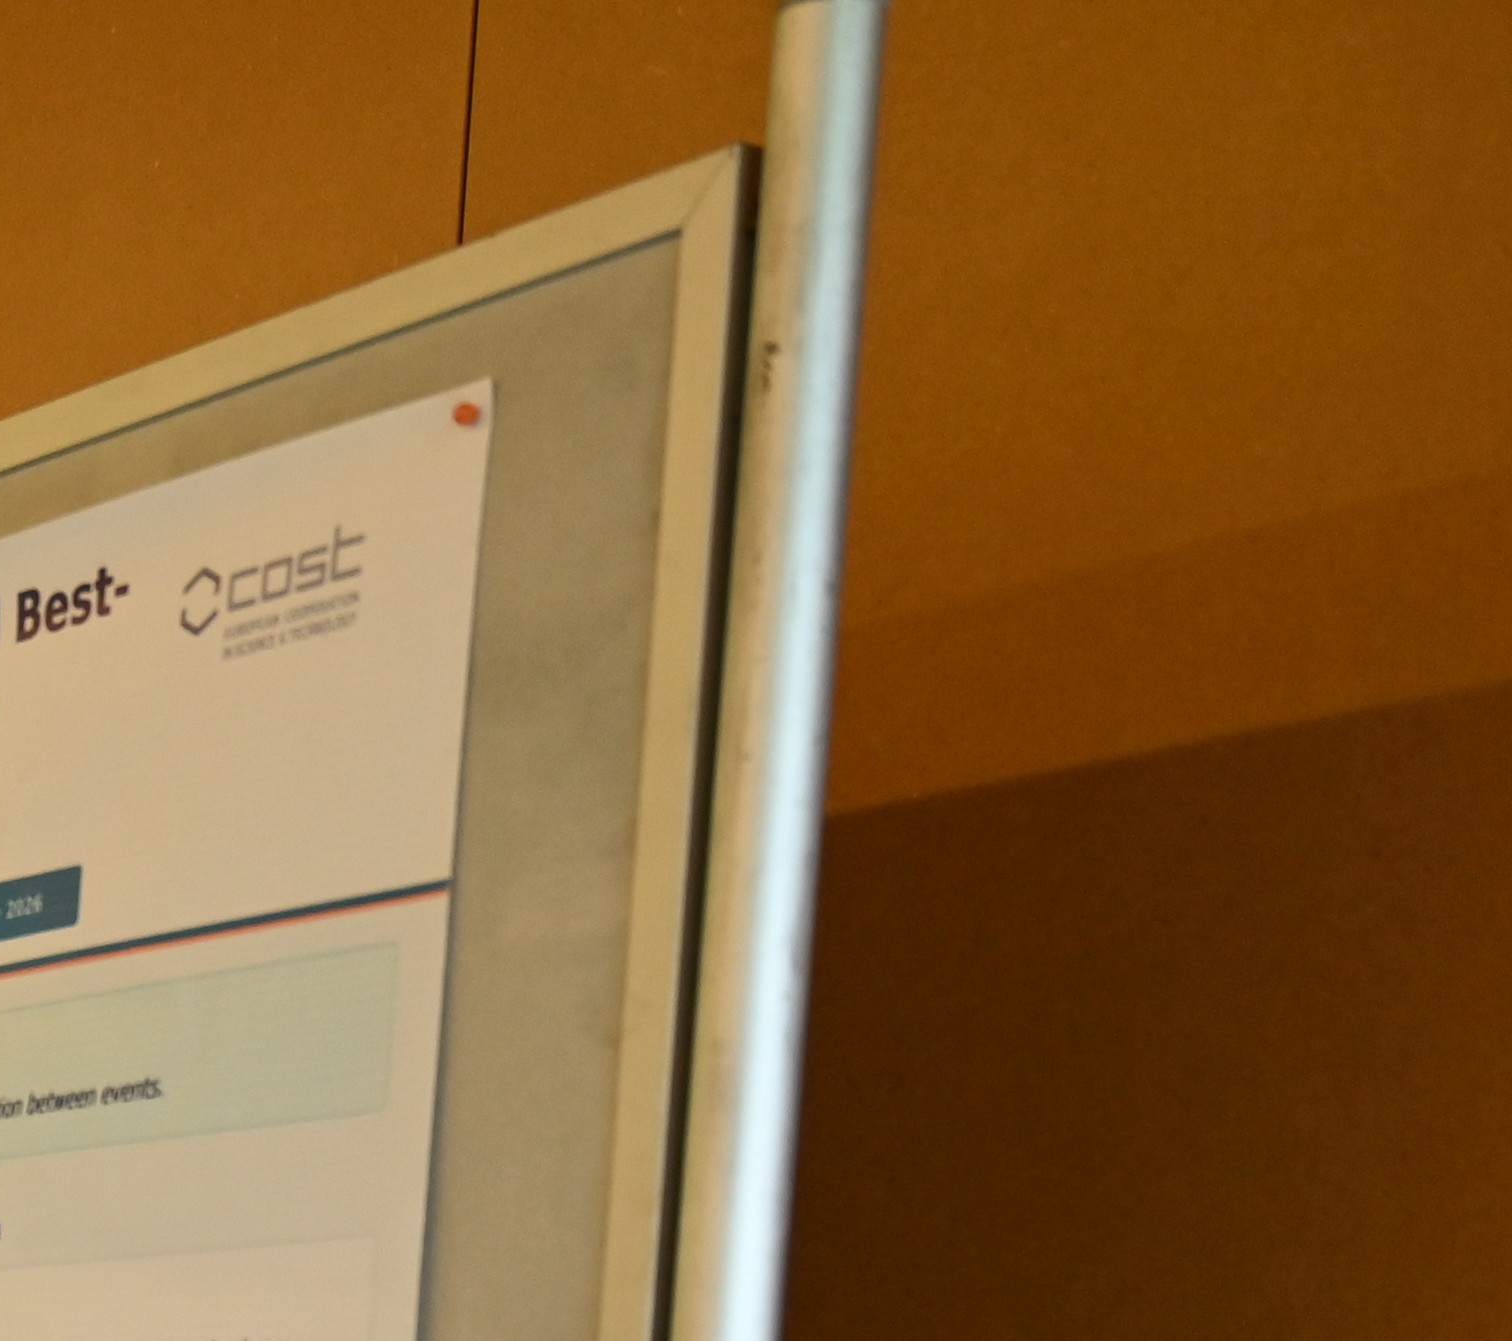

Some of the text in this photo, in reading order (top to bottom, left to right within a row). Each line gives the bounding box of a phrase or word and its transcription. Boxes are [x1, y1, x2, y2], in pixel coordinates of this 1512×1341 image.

[15, 567, 129, 642] Best-
[227, 524, 367, 613] cost
[25, 1088, 98, 1116] between
[99, 1077, 163, 1106] events.
